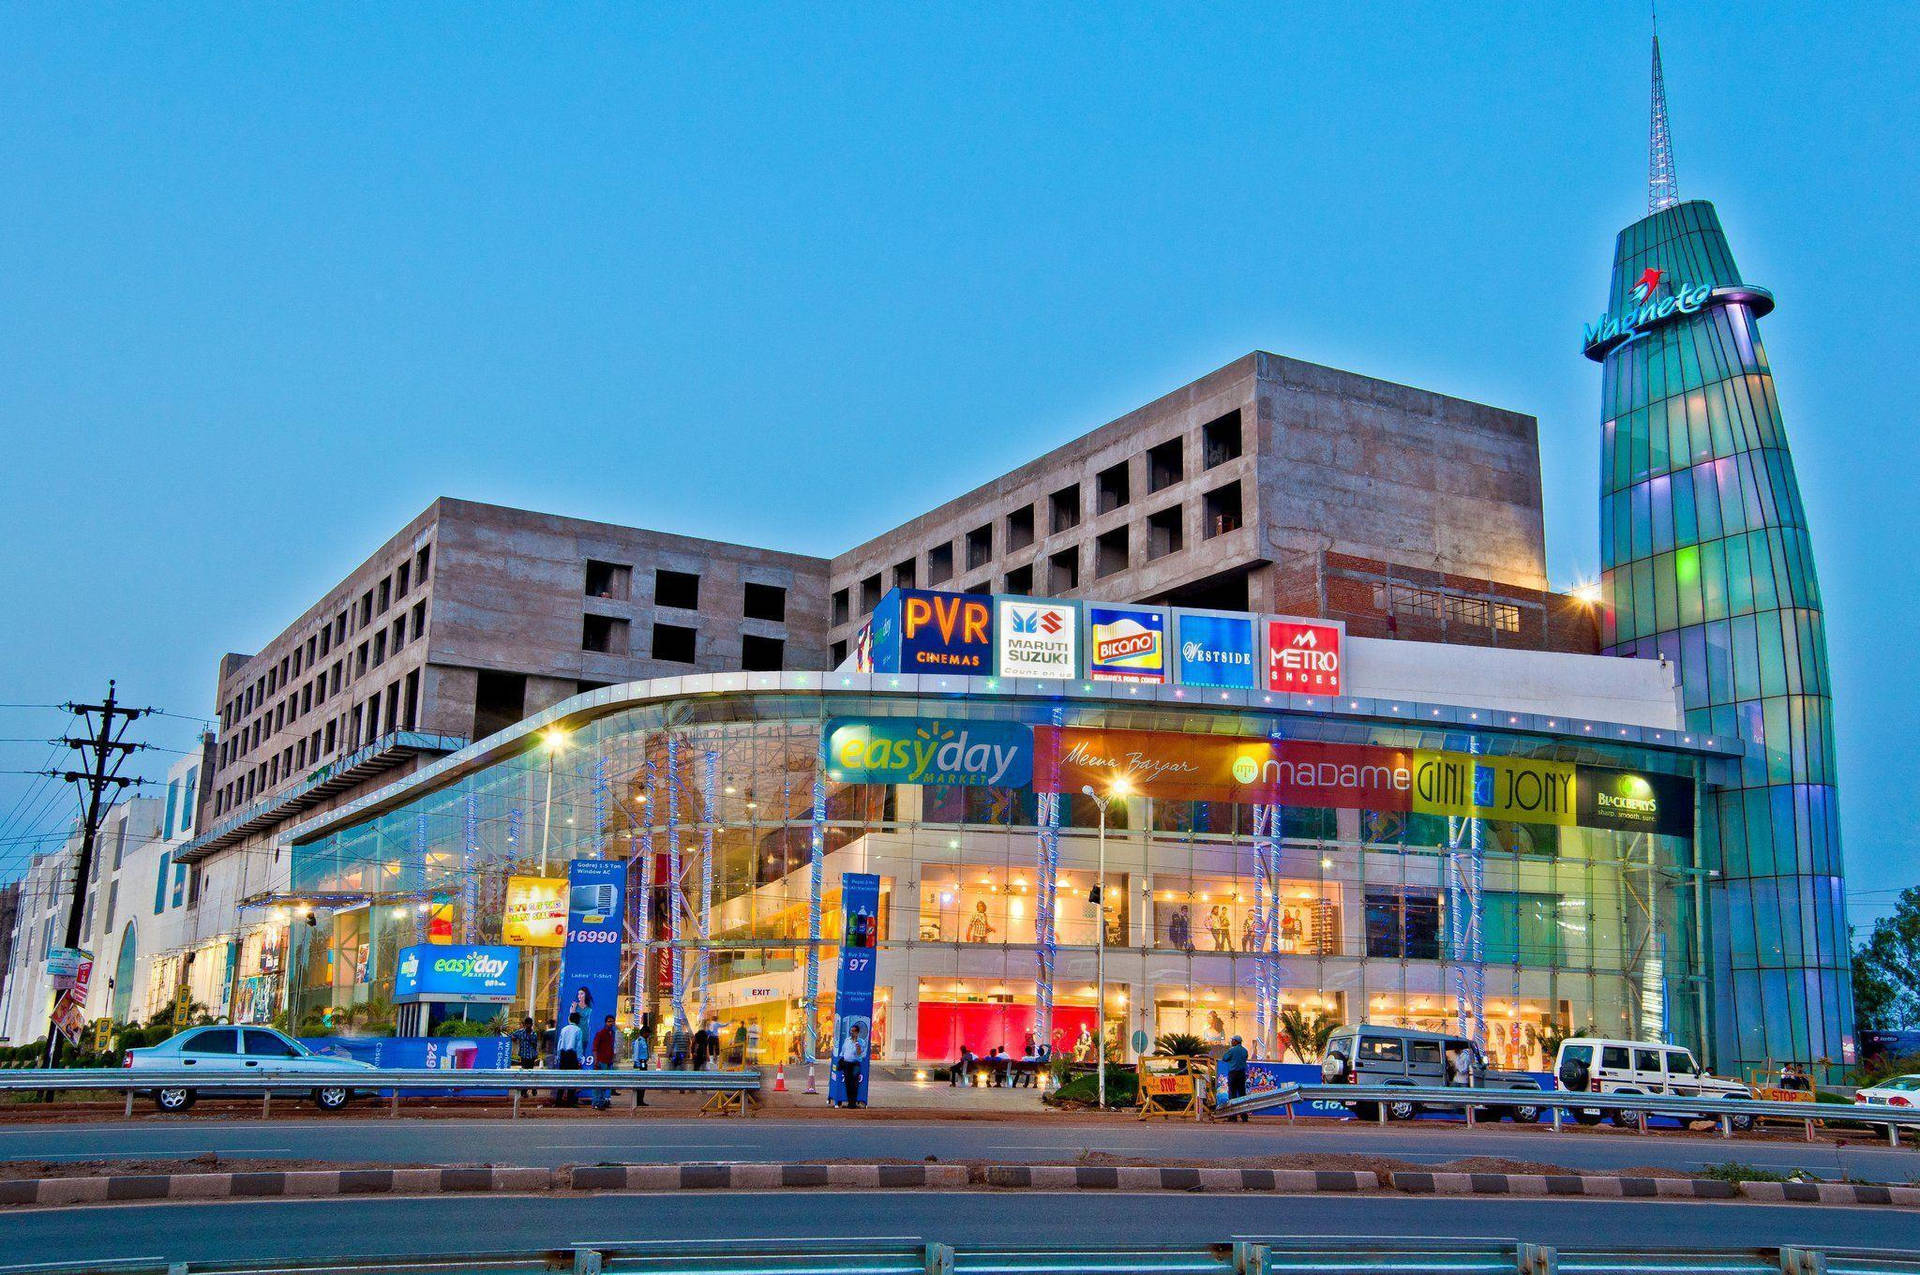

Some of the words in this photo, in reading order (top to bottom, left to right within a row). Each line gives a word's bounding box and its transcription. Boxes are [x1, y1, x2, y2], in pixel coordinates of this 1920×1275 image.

[1580, 282, 1712, 355] Magneto
[906, 596, 989, 646] PVR
[1007, 639, 1068, 652] MARUTI
[1182, 641, 1251, 665] WESTSIDE
[916, 651, 980, 667] CINEMAS
[1008, 650, 1068, 665] SUZUKI
[1270, 647, 1338, 672] METRO
[1271, 671, 1337, 686] SHOES
[840, 730, 1018, 785] easyday
[1060, 741, 1121, 769] Meena
[1126, 752, 1200, 783] Bazaar
[922, 773, 987, 785] MARKET
[1417, 761, 1465, 806] GINI
[1504, 768, 1571, 814] JONY
[567, 929, 618, 944] 16990
[434, 954, 509, 978] easyday
[849, 958, 869, 971] 97
[751, 988, 771, 996] EXIT
[426, 1042, 438, 1069] 249
[1160, 1077, 1177, 1093] STOP
[1771, 1089, 1797, 1101] STOP
